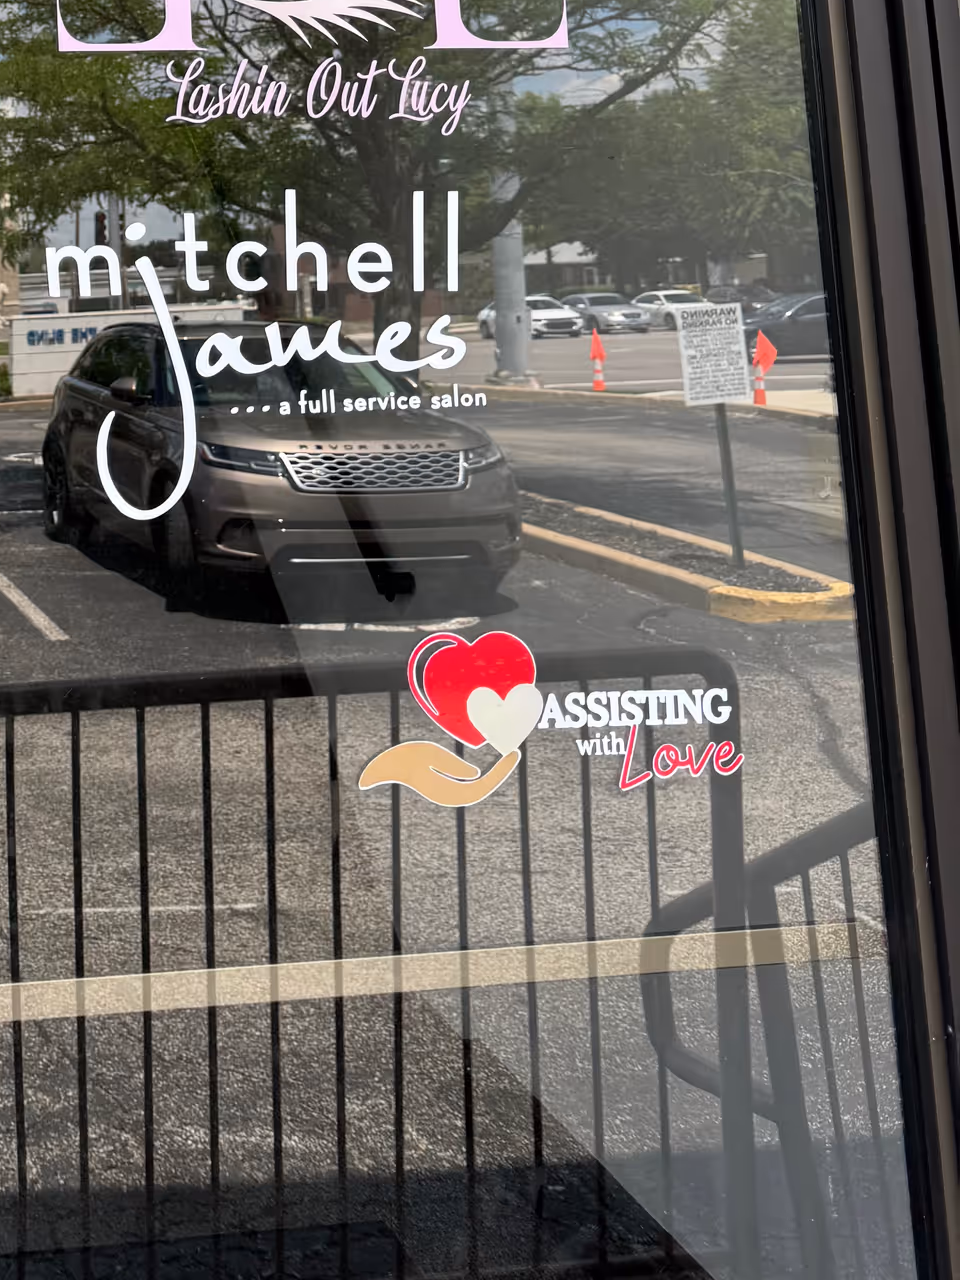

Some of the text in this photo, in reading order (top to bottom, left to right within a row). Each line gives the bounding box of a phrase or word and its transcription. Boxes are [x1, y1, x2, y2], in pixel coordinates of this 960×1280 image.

[165, 55, 472, 136] Lashin Out Lucy
[45, 189, 459, 297] mitchell
[298, 389, 336, 414] full
[343, 392, 421, 412] service
[431, 383, 487, 410] salon
[538, 687, 732, 729] ASSISTING
[576, 723, 744, 791] with Love
